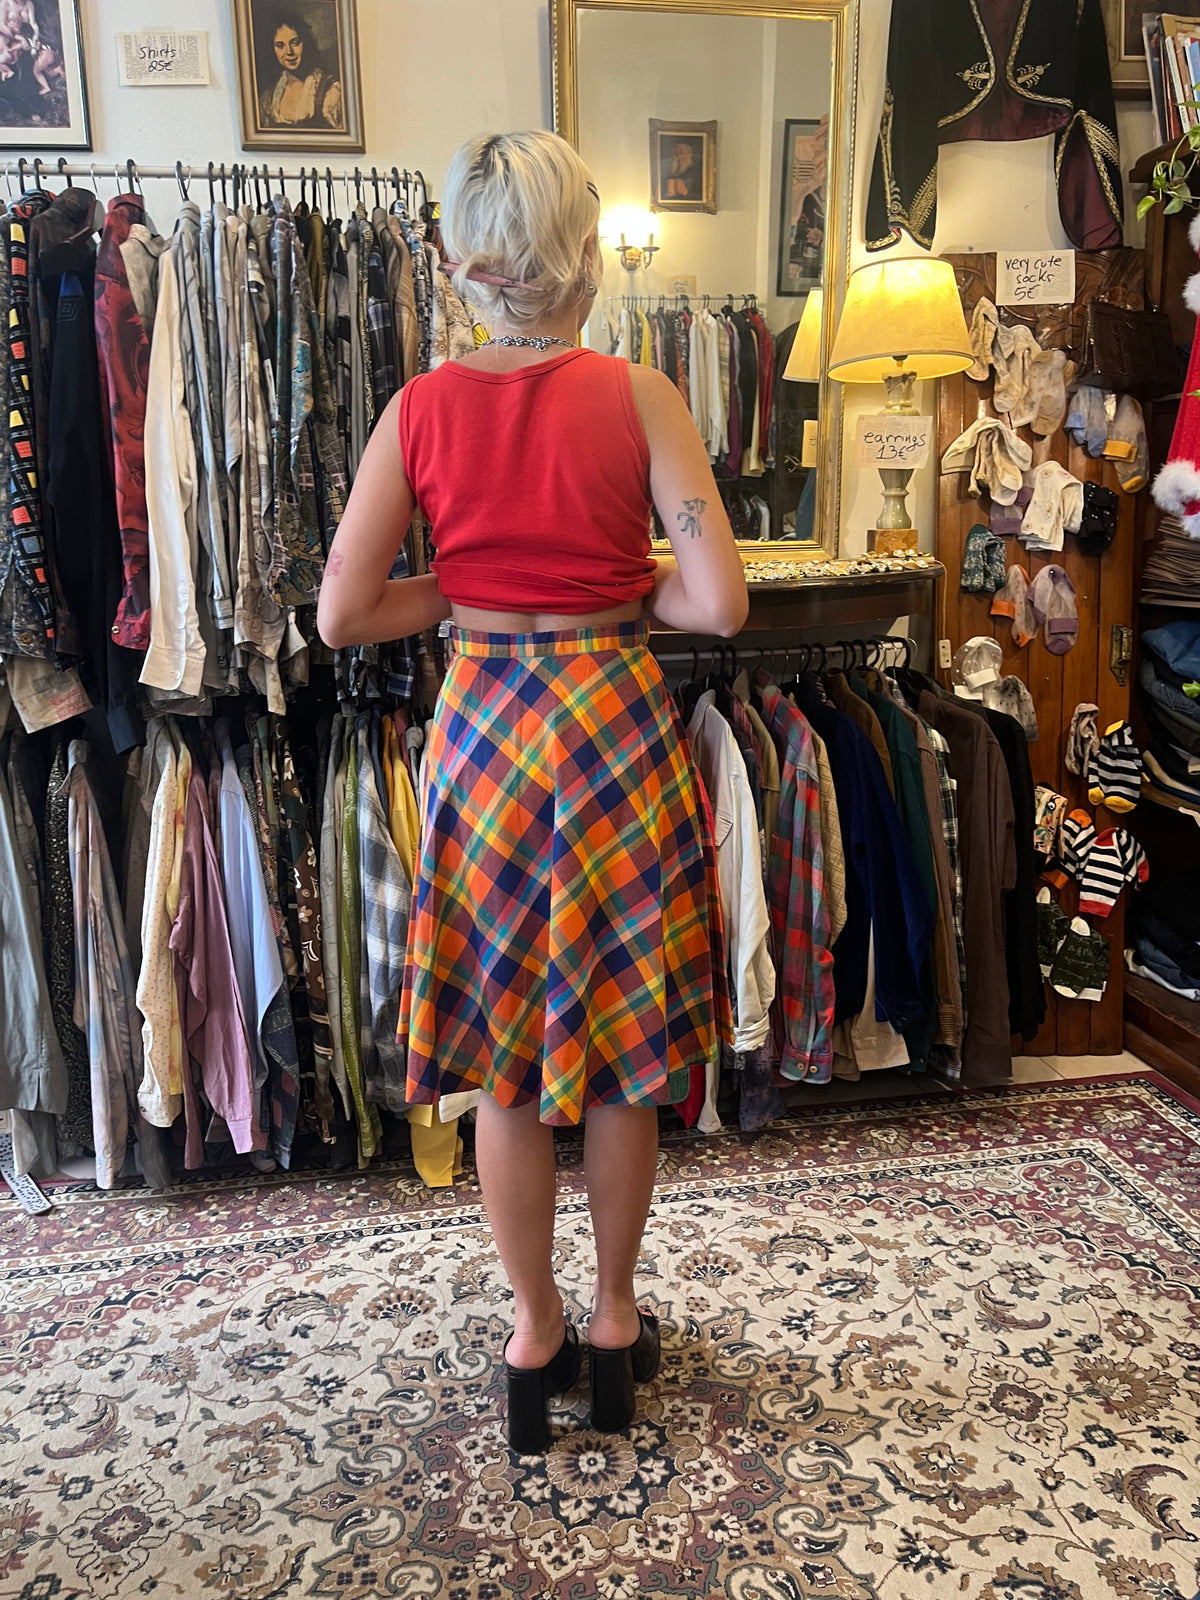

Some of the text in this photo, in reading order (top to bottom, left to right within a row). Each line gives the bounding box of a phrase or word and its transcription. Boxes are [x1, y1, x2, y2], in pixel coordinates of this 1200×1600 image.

[148, 60, 173, 72] 25€
[1005, 255, 1062, 274] very cute
[1016, 269, 1055, 284] socks
[1014, 284, 1041, 301] 5€
[864, 431, 927, 452] earrings
[876, 444, 907, 460] 13€
